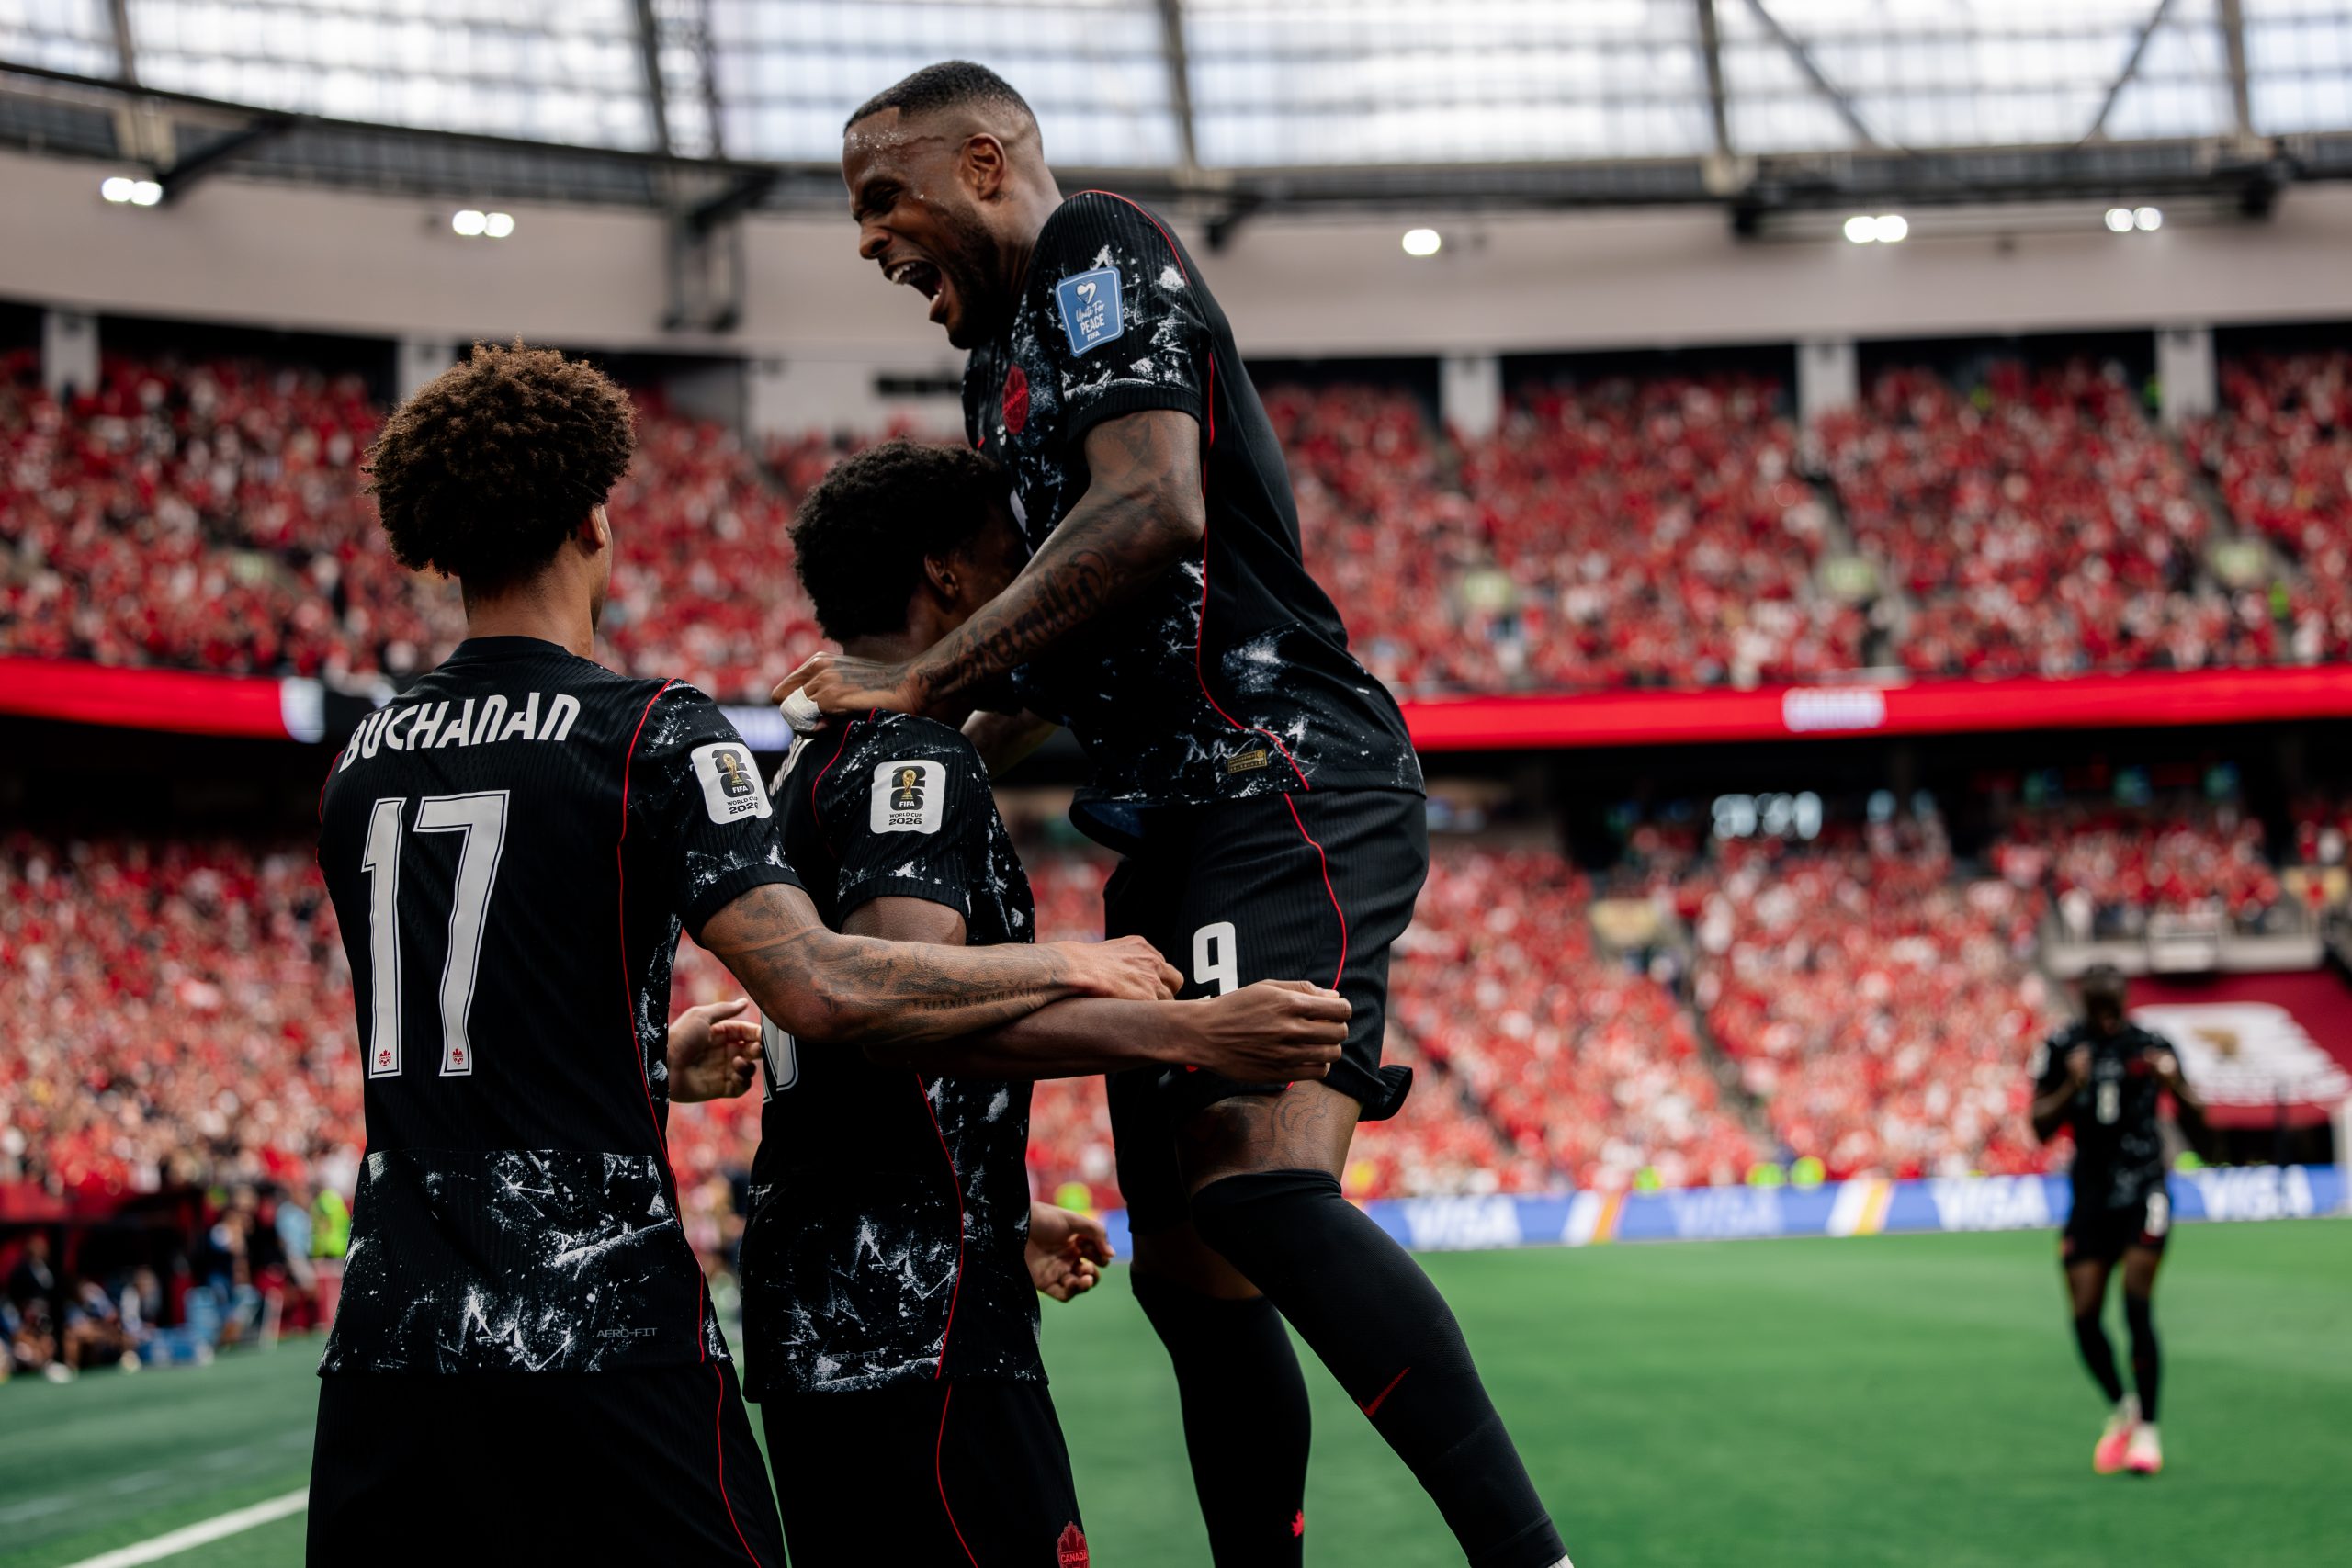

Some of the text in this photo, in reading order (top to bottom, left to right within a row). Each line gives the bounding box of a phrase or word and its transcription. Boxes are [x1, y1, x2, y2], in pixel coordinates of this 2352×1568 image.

[1080, 313, 1105, 335] PEACE
[338, 692, 581, 773] BUCHANAN
[732, 785, 749, 794] FIFA
[727, 797, 748, 806] WORLD
[888, 818, 922, 826] 2026
[361, 789, 510, 1079] 17
[1193, 921, 1238, 1000] 9
[596, 1327, 658, 1338] AERO-FIT
[1060, 1552, 1088, 1563] CANADA
